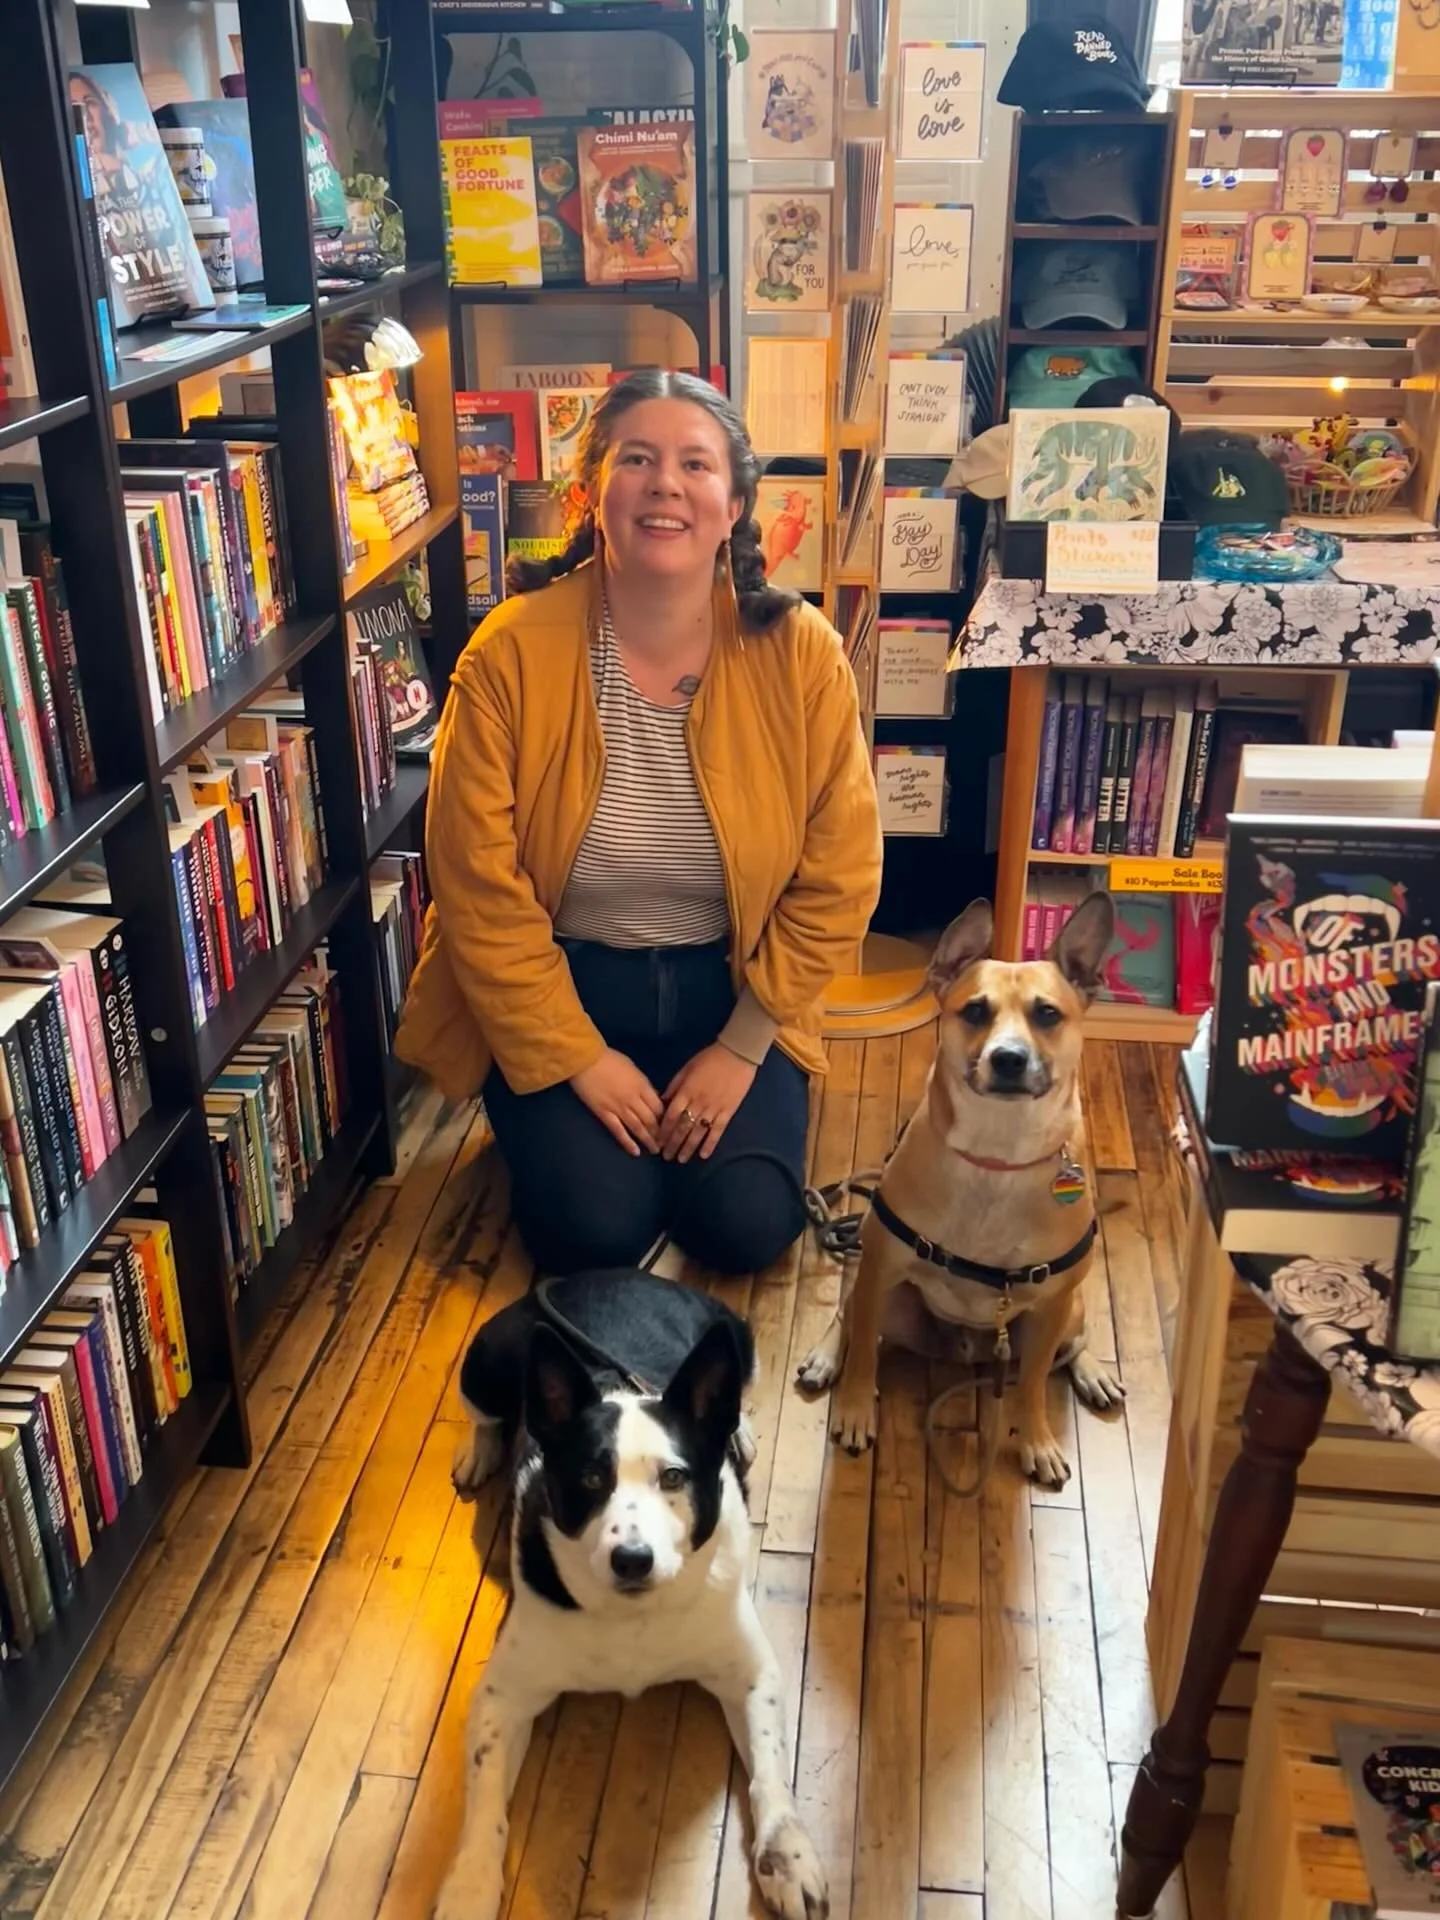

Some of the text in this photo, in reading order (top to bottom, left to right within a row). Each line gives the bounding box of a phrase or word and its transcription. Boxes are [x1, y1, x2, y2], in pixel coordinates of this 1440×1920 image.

[922, 67, 961, 97] love
[934, 98, 954, 114] is
[595, 129, 678, 144] Chimi Nu'am
[917, 114, 966, 141] love
[453, 144, 507, 157] FEASTS
[455, 158, 474, 168] OF
[456, 168, 499, 180] GOOD
[457, 179, 525, 192] FORTUNE
[98, 206, 170, 240] POWER
[110, 247, 186, 284] STYLE
[796, 264, 816, 276] FOR
[805, 276, 825, 289] YOU
[512, 369, 596, 389] TABOON
[898, 413, 947, 424] STRAIGHT
[256, 455, 272, 538] ROSEWATER
[461, 490, 497, 502] ood?
[1053, 524, 1109, 547] Prints
[900, 535, 943, 569] Day!
[1057, 545, 1128, 563] Stickers
[356, 597, 413, 643] IMONA
[26, 590, 57, 729] MEXICAN GOTHIC
[1097, 776, 1114, 822] BITTER
[1114, 776, 1130, 822] BITTER
[1142, 877, 1200, 888] Paperbacks
[1173, 867, 1223, 879] Sale Boo
[1308, 914, 1365, 951] OF
[1248, 934, 1440, 997] MONSTERS
[46, 1000, 53, 1009] A
[1333, 979, 1391, 1019] AND
[119, 975, 142, 1058] HARROW
[48, 1010, 66, 1085] DESOLATION
[105, 994, 129, 1078] GIDEON
[7, 1041, 13, 1051] A
[10, 1054, 26, 1111] MEMORY
[22, 1114, 34, 1162] CALLED
[29, 1017, 67, 1186] A DESOLATION CALLED PEACE
[62, 1087, 75, 1129] CALLED
[69, 1131, 81, 1165] PEACE
[12, 1446, 43, 1557] GODLY HEATHENS
[1376, 1765, 1440, 1779] CONCR
[1408, 1779, 1440, 1793] KID
